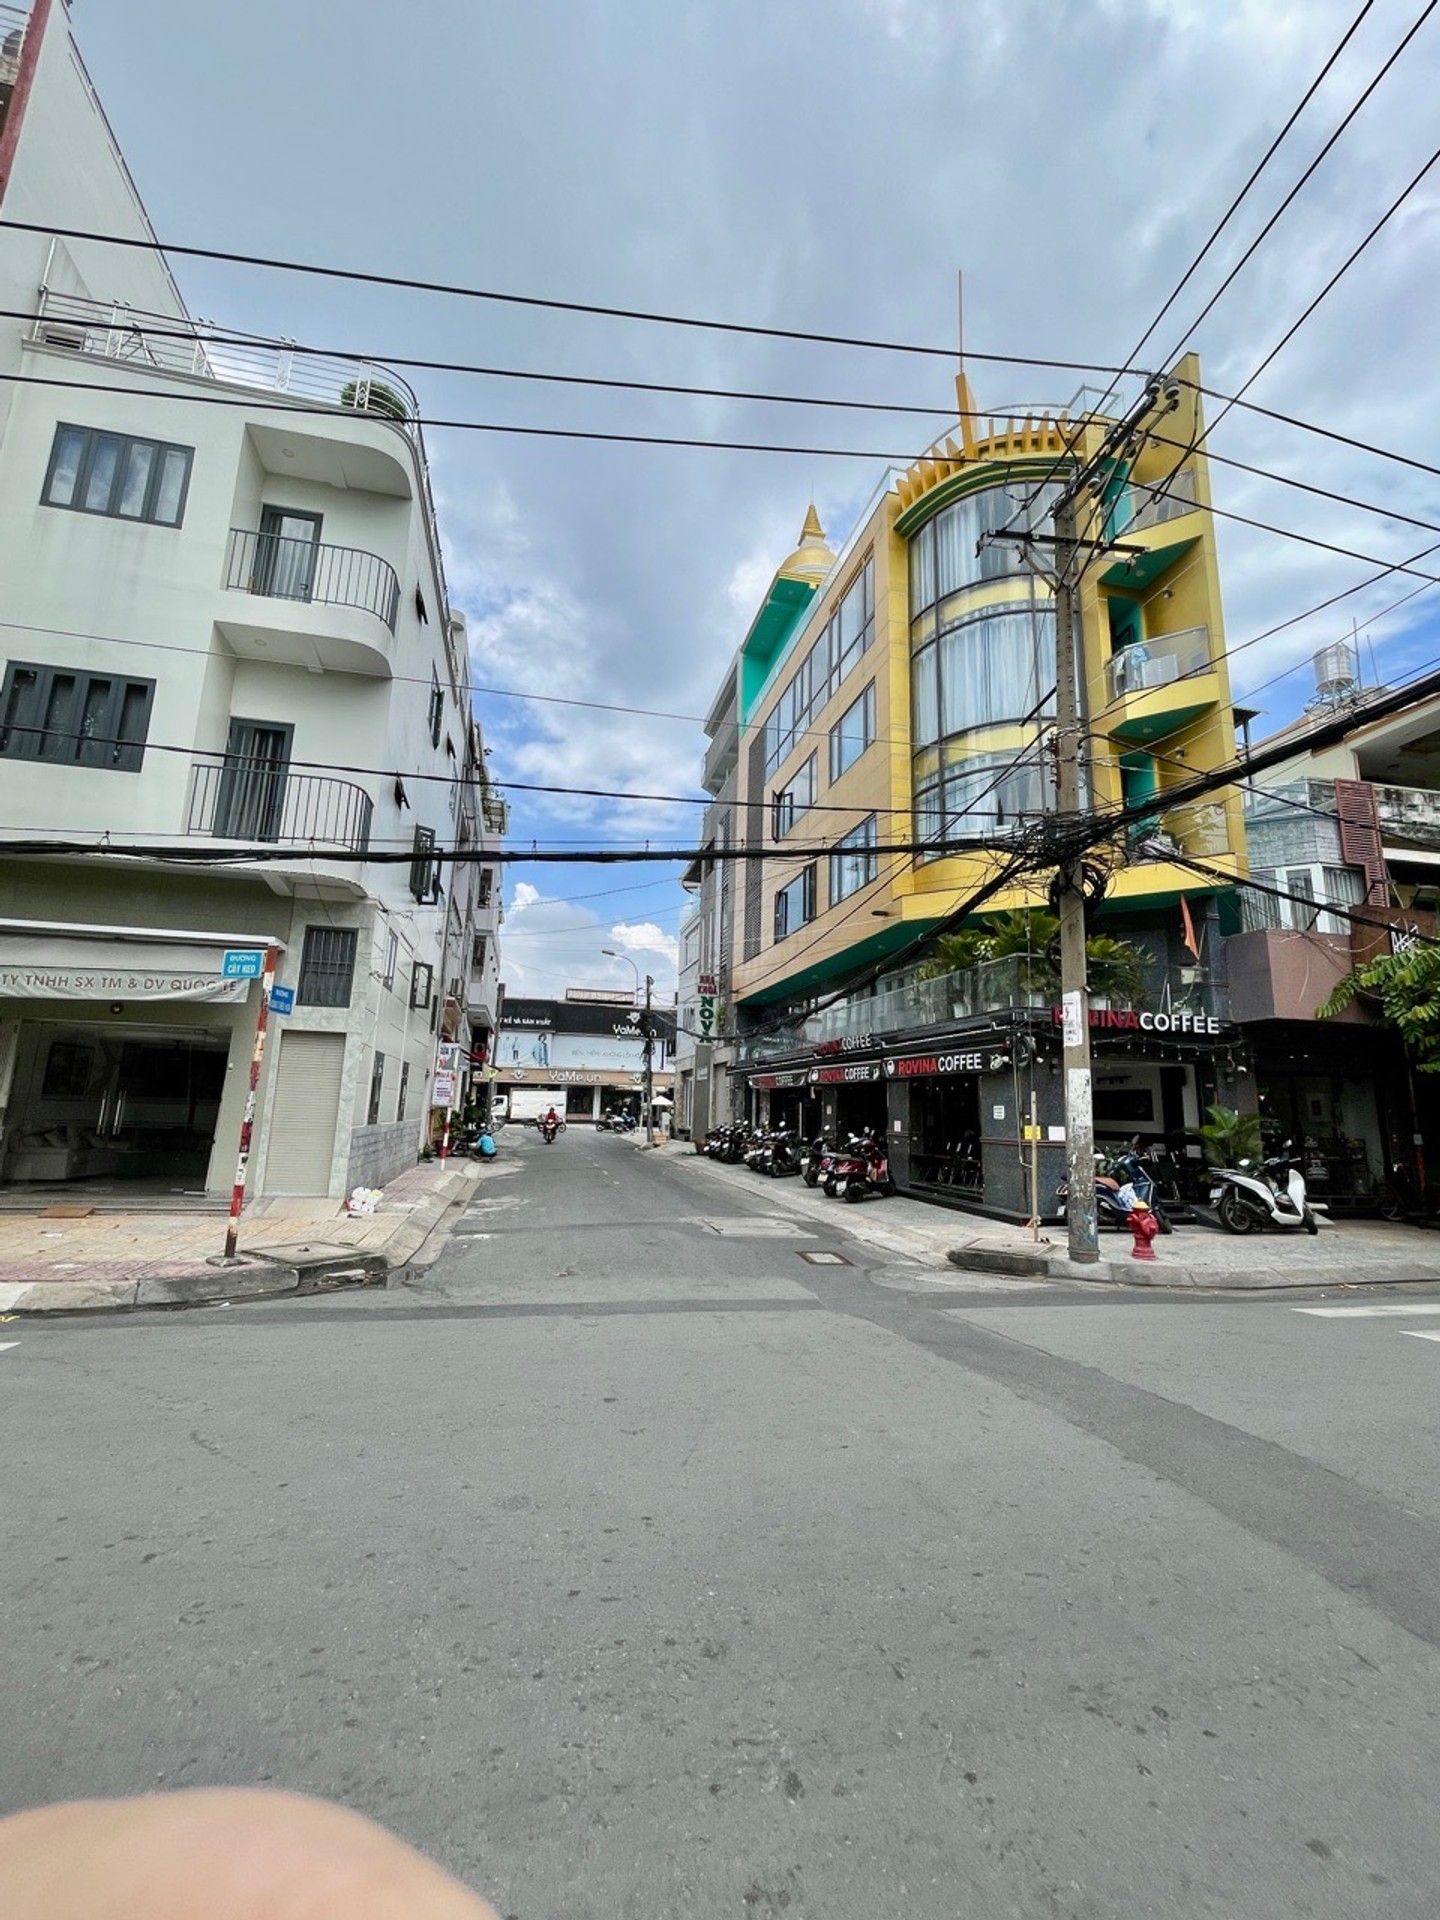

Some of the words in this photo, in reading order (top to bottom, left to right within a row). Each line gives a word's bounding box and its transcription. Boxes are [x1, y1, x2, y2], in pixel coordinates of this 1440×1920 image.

[1, 974, 19, 985] TY
[25, 975, 69, 987] TNHH
[75, 976, 94, 988] SX
[101, 977, 121, 988] TM
[127, 978, 138, 989] &
[144, 979, 164, 989] DV
[612, 1024, 657, 1037] YaMe.n
